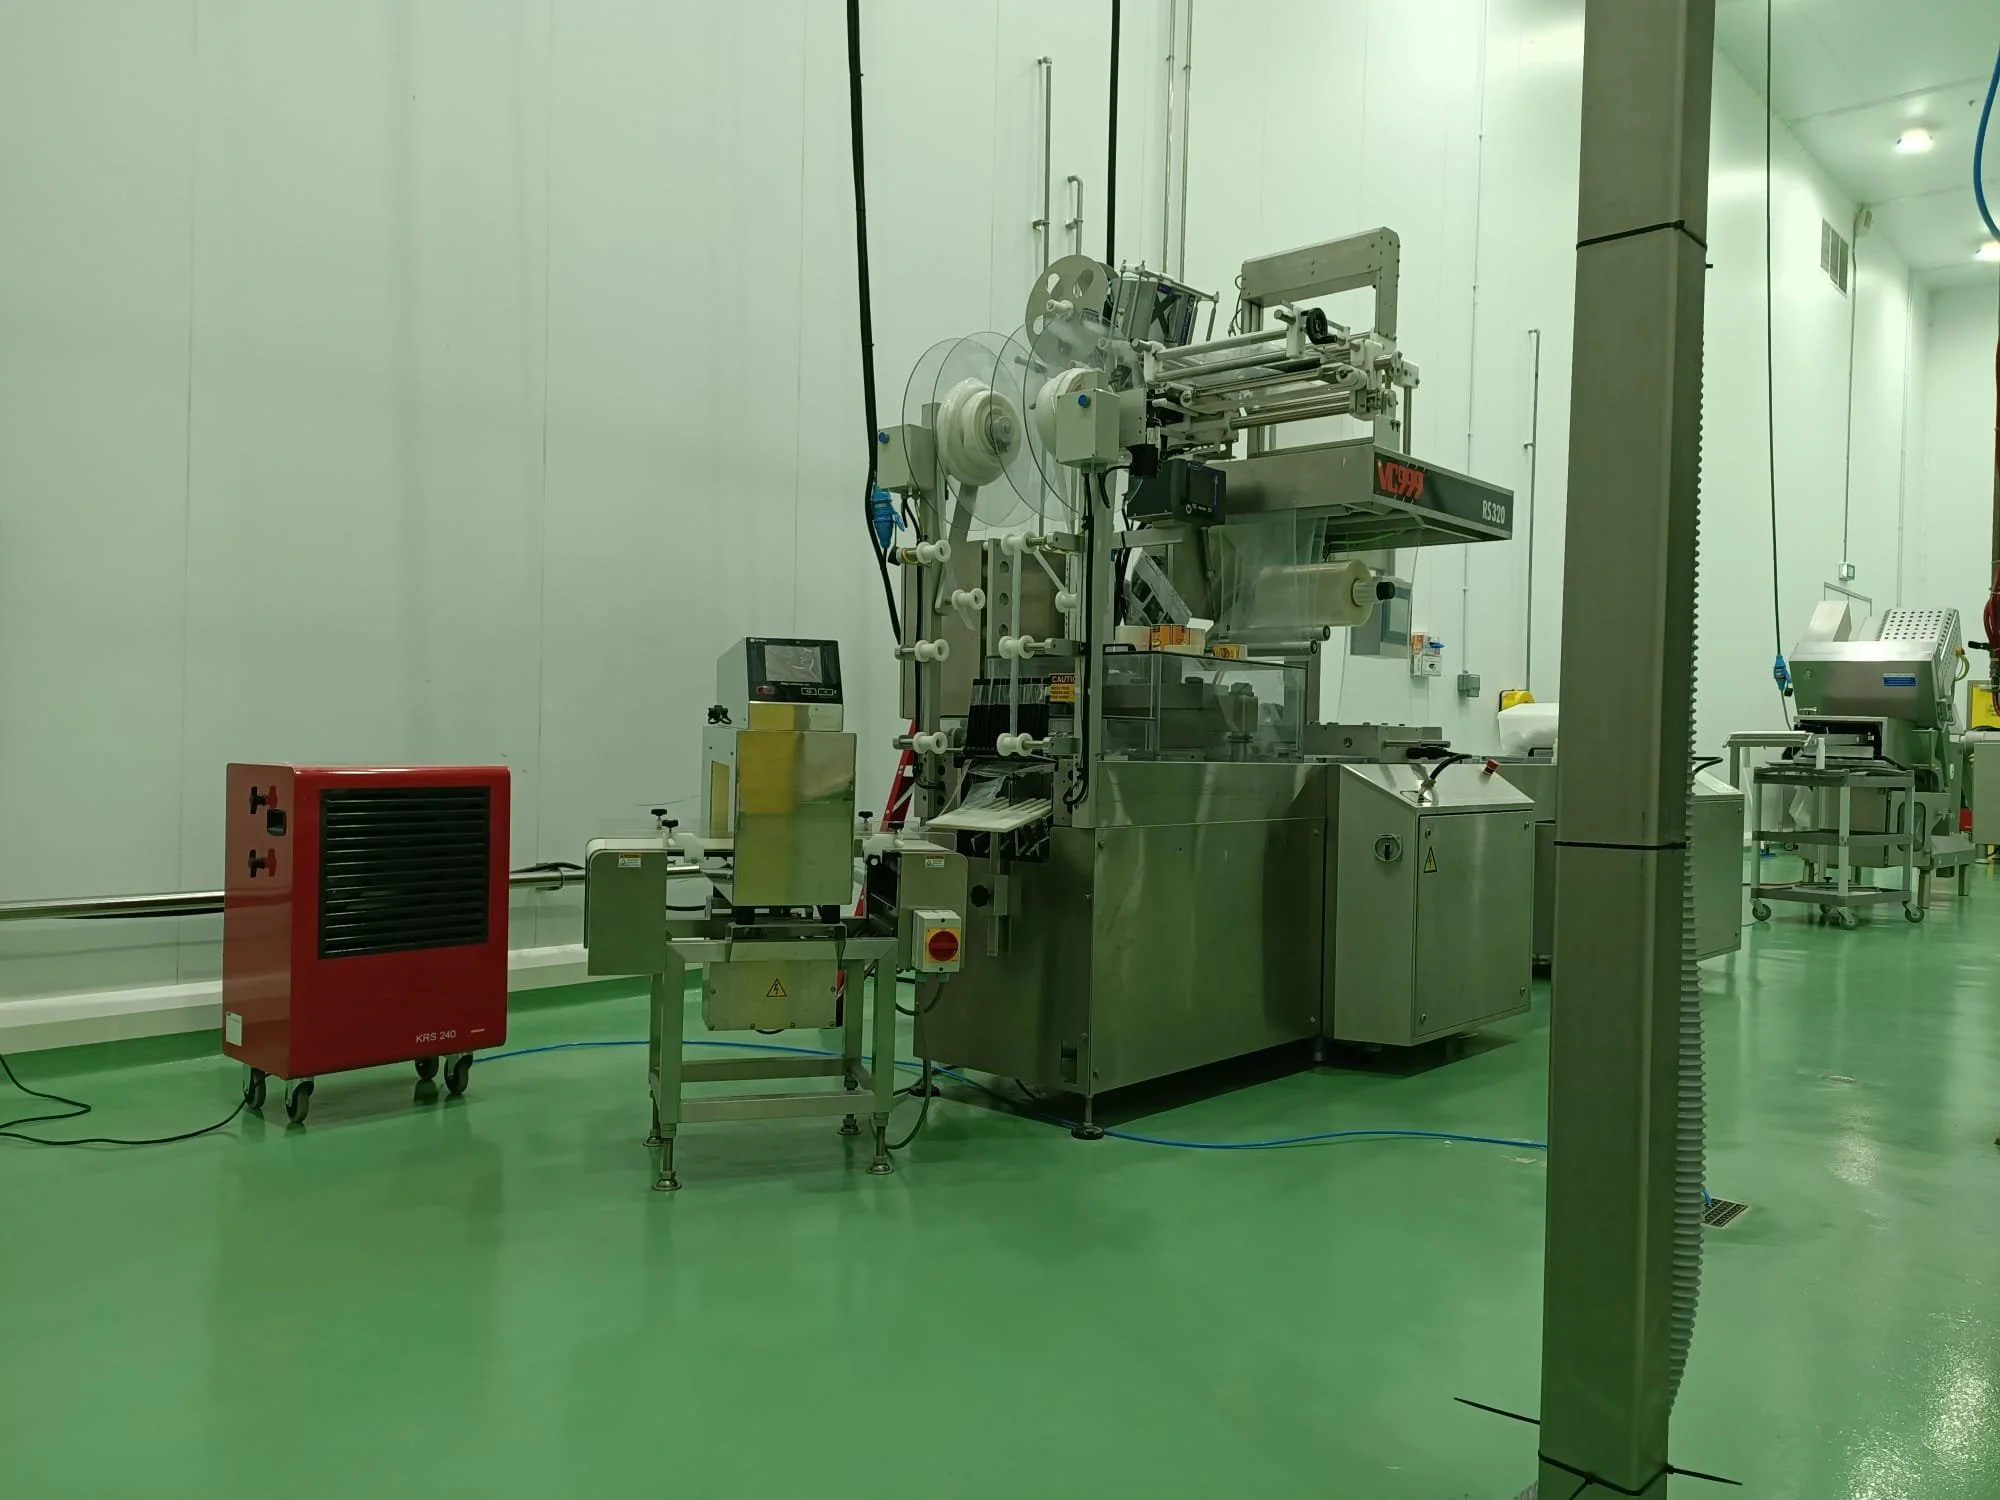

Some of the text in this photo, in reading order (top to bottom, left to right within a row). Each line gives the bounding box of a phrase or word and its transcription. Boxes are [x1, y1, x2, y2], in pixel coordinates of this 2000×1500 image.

[1377, 460, 1424, 499] VC999
[1482, 500, 1506, 524] RS320
[1051, 675, 1076, 683] CAUTI
[415, 1030, 457, 1044] KRS 240
